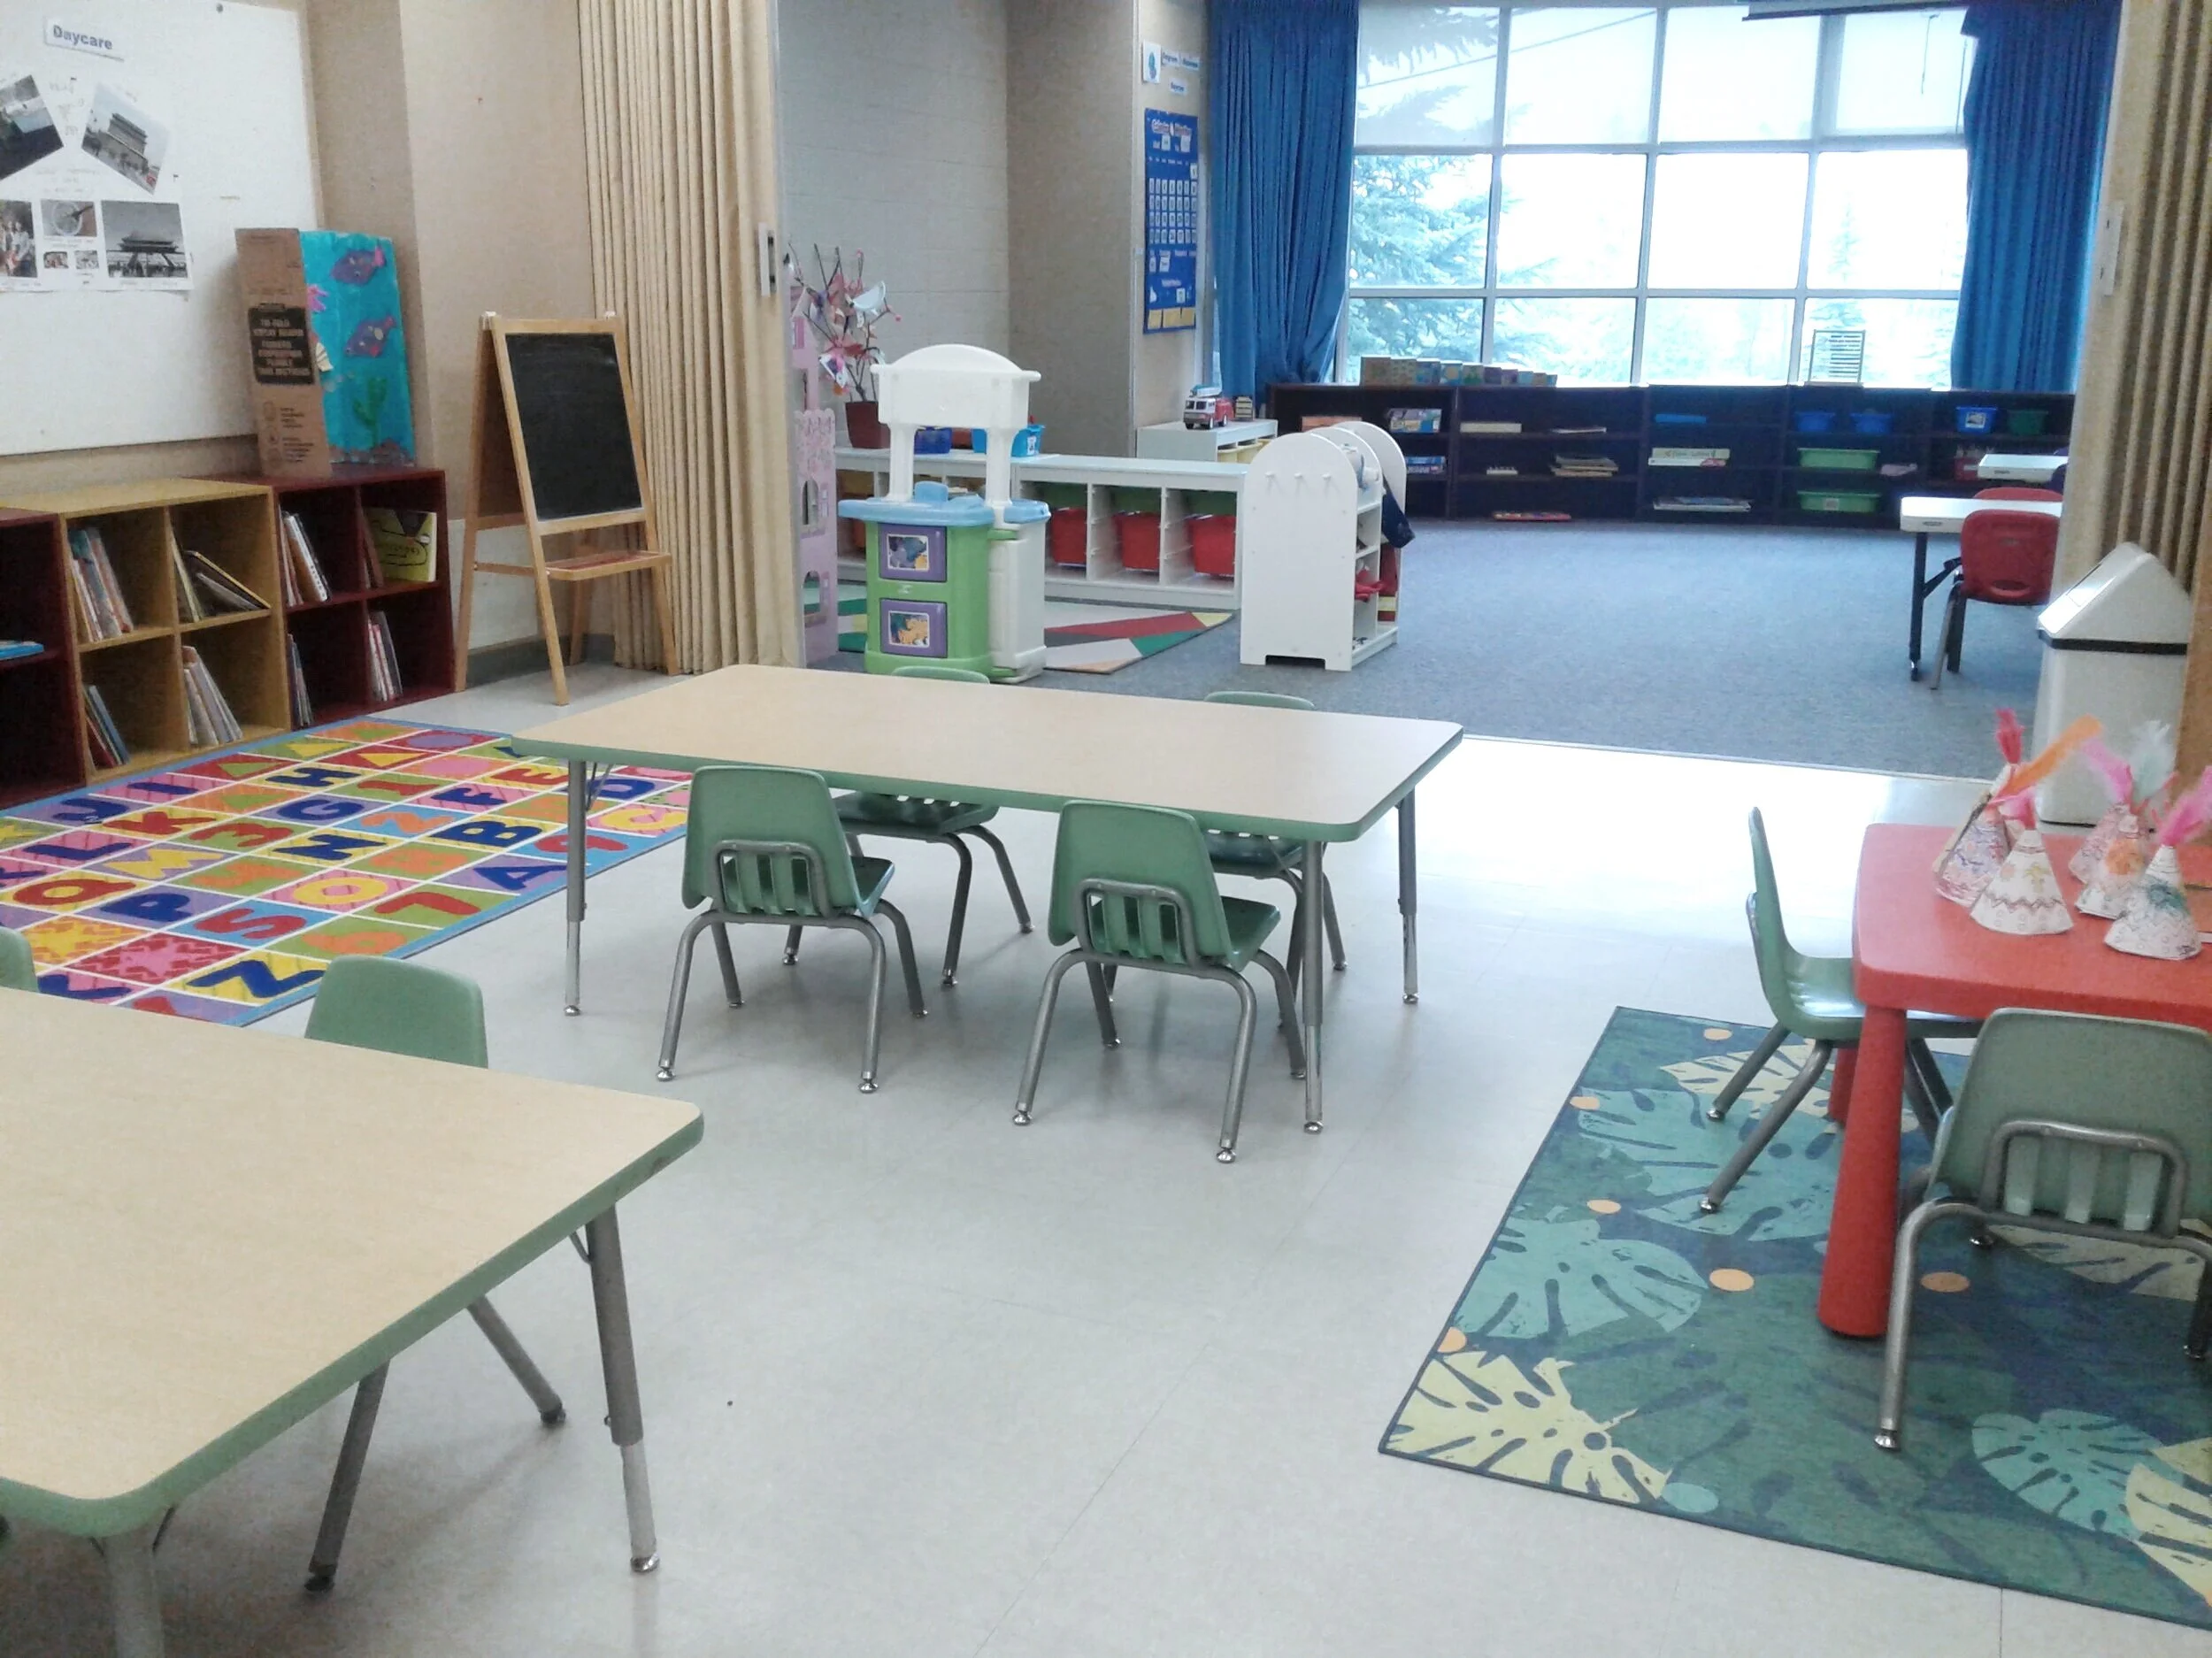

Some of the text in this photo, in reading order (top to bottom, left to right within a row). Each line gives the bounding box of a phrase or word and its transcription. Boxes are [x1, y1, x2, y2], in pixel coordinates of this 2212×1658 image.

[53, 24, 113, 50] Daycare
[265, 767, 361, 787] H
[430, 787, 508, 805] F
[52, 798, 130, 825] J
[102, 811, 217, 835] K
[276, 799, 365, 821] G
[360, 810, 452, 833] 2
[597, 808, 687, 831] C
[188, 822, 294, 848] 3
[273, 834, 387, 861] N
[429, 821, 542, 848] B
[22, 842, 132, 860] L
[367, 848, 468, 875] 8
[101, 849, 225, 880] M
[472, 864, 567, 890] A
[12, 879, 136, 906] Q
[373, 892, 481, 915] 7
[99, 893, 194, 923] P
[301, 931, 408, 956] 6
[185, 960, 327, 998] Z
